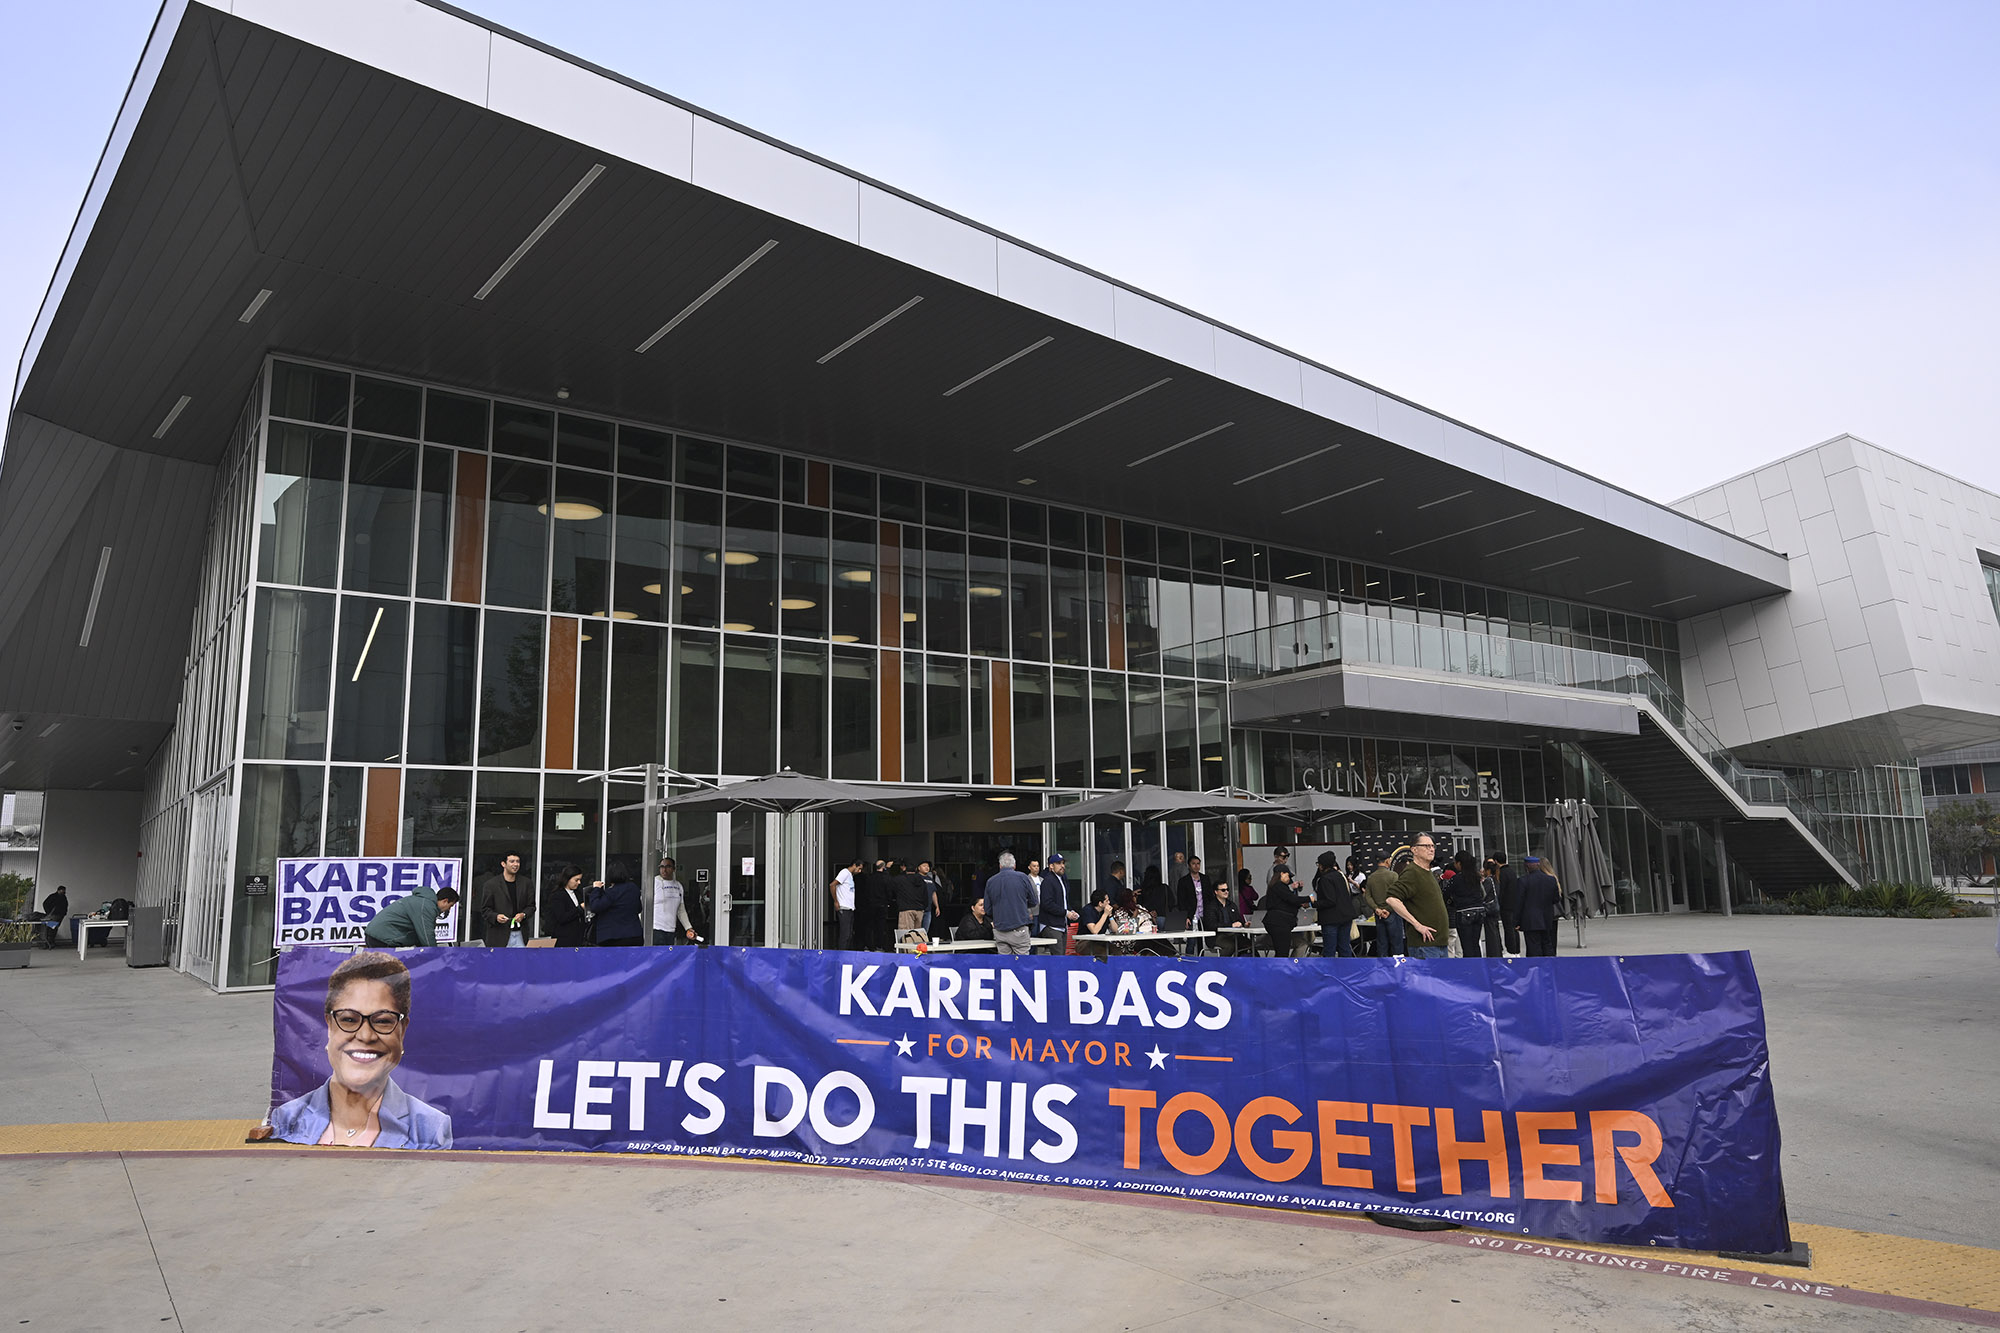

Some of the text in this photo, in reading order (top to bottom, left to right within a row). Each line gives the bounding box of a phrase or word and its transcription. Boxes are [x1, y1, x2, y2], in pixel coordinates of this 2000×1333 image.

[1303, 767, 1500, 799] CULINARY ARTS E3
[283, 862, 454, 893] KAREN
[281, 927, 325, 942] FOR
[839, 963, 1233, 1030] KAREN BASS
[927, 1033, 1133, 1067] FOR MAYOR
[533, 1059, 1675, 1209] LET'S DO THIS TOGETHER
[627, 1142, 651, 1151] PAID
[768, 1149, 803, 1160] MAYOR
[831, 1156, 850, 1164] 777
[850, 1157, 858, 1165] S
[858, 1157, 909, 1167] FIGUEROA
[910, 1157, 925, 1168] ST,
[926, 1159, 948, 1170] STE
[949, 1161, 976, 1174] 4050
[976, 1166, 997, 1176] LOS
[999, 1170, 1052, 1183] ANGELES,
[1054, 1176, 1069, 1184] CA
[1072, 1178, 1109, 1188] 90017.
[1113, 1180, 1187, 1196] ADDITIONAL
[1189, 1187, 1275, 1203] INFORMATION
[1276, 1195, 1290, 1203] IS
[1290, 1197, 1361, 1210] AVAILABLE
[1363, 1203, 1381, 1211] AT
[1382, 1206, 1516, 1224] ETHICS.LACITY.ORG
[1468, 1236, 1836, 1298] NO PARKING FIRE LANE
